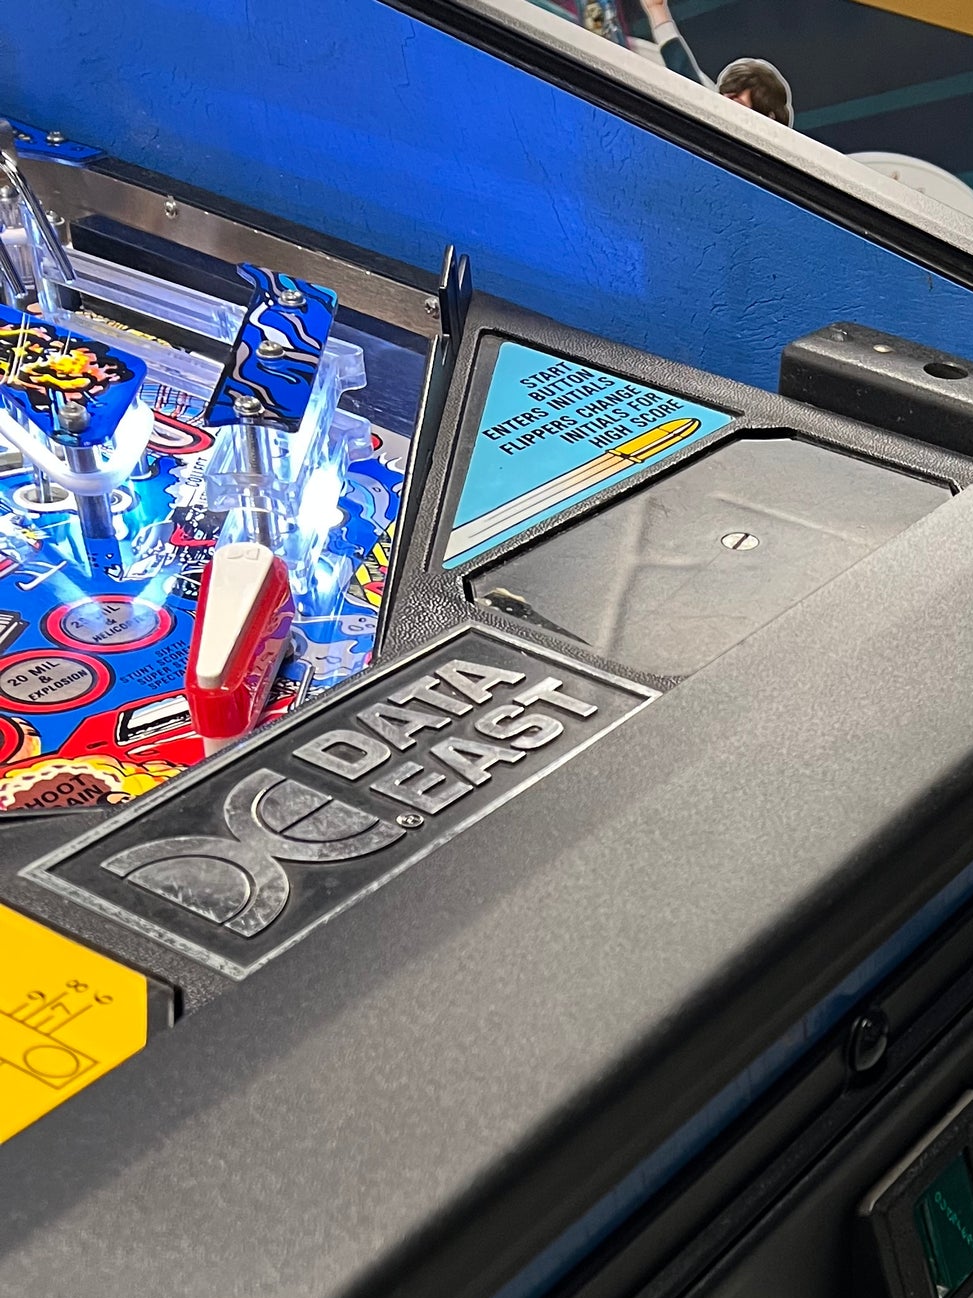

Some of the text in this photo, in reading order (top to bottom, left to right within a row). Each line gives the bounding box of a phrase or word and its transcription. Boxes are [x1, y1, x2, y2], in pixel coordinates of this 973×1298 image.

[521, 362, 573, 389] START
[528, 369, 594, 402] BUTTON
[482, 376, 616, 440] ENTERS INITIALS
[500, 385, 641, 455] FLIPPERS CHANGE
[560, 393, 664, 444] INITIALS FOR
[589, 399, 684, 448] HIGH SCORE
[119, 663, 154, 684] STUNT
[156, 645, 190, 666] SCORE
[155, 640, 187, 658] SIXTH
[7, 661, 61, 688] 20 MIL
[28, 669, 88, 702] EXPLOSION
[39, 675, 53, 685] &
[137, 666, 172, 686] SUPER
[292, 659, 526, 781] DATA
[369, 676, 599, 815] EAST
[20, 774, 87, 809] HOOT
